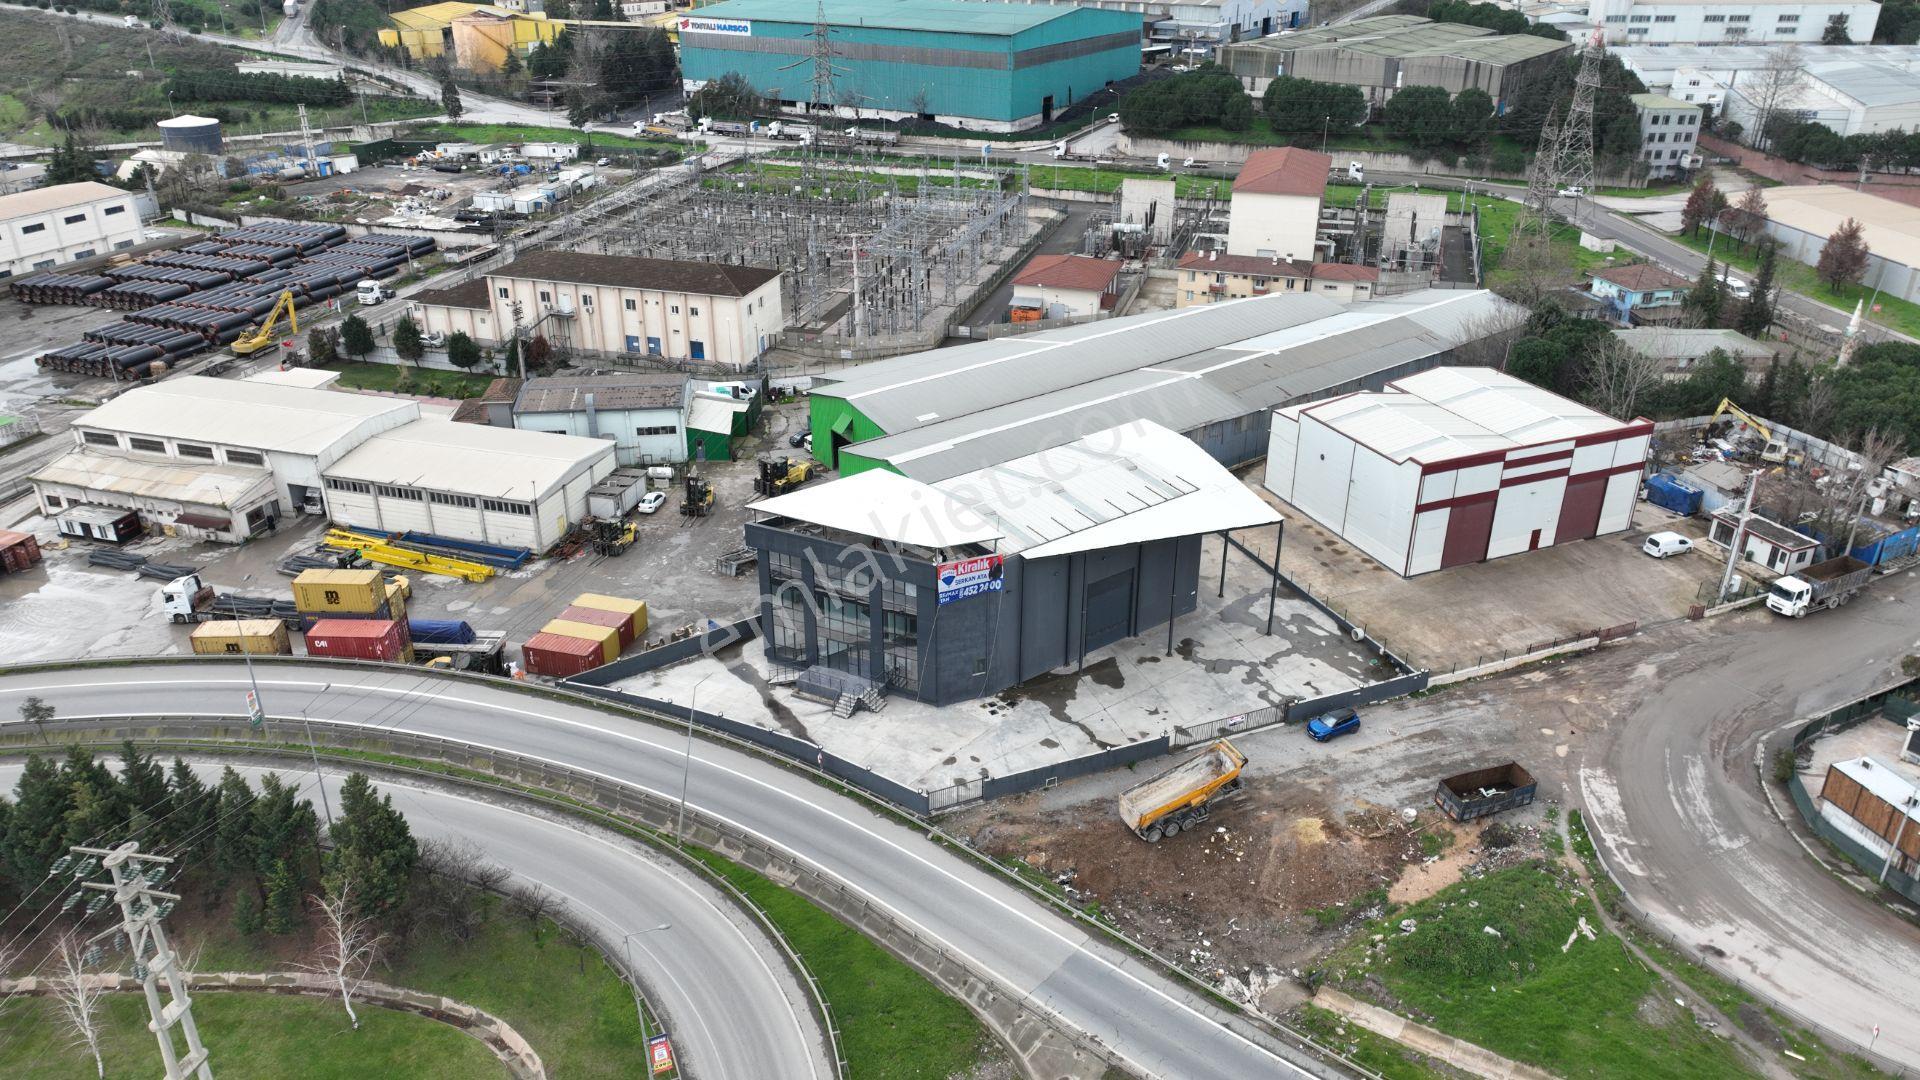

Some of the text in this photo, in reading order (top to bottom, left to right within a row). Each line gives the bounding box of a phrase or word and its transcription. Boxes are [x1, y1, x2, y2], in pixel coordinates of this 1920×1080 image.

[717, 24, 748, 33] HARSCO
[957, 559, 990, 575] Kiralık
[955, 576, 976, 586] SERKAN
[964, 585, 978, 596] 452
[979, 582, 989, 592] 24
[990, 580, 1001, 590] 00
[315, 640, 328, 648] CAI
